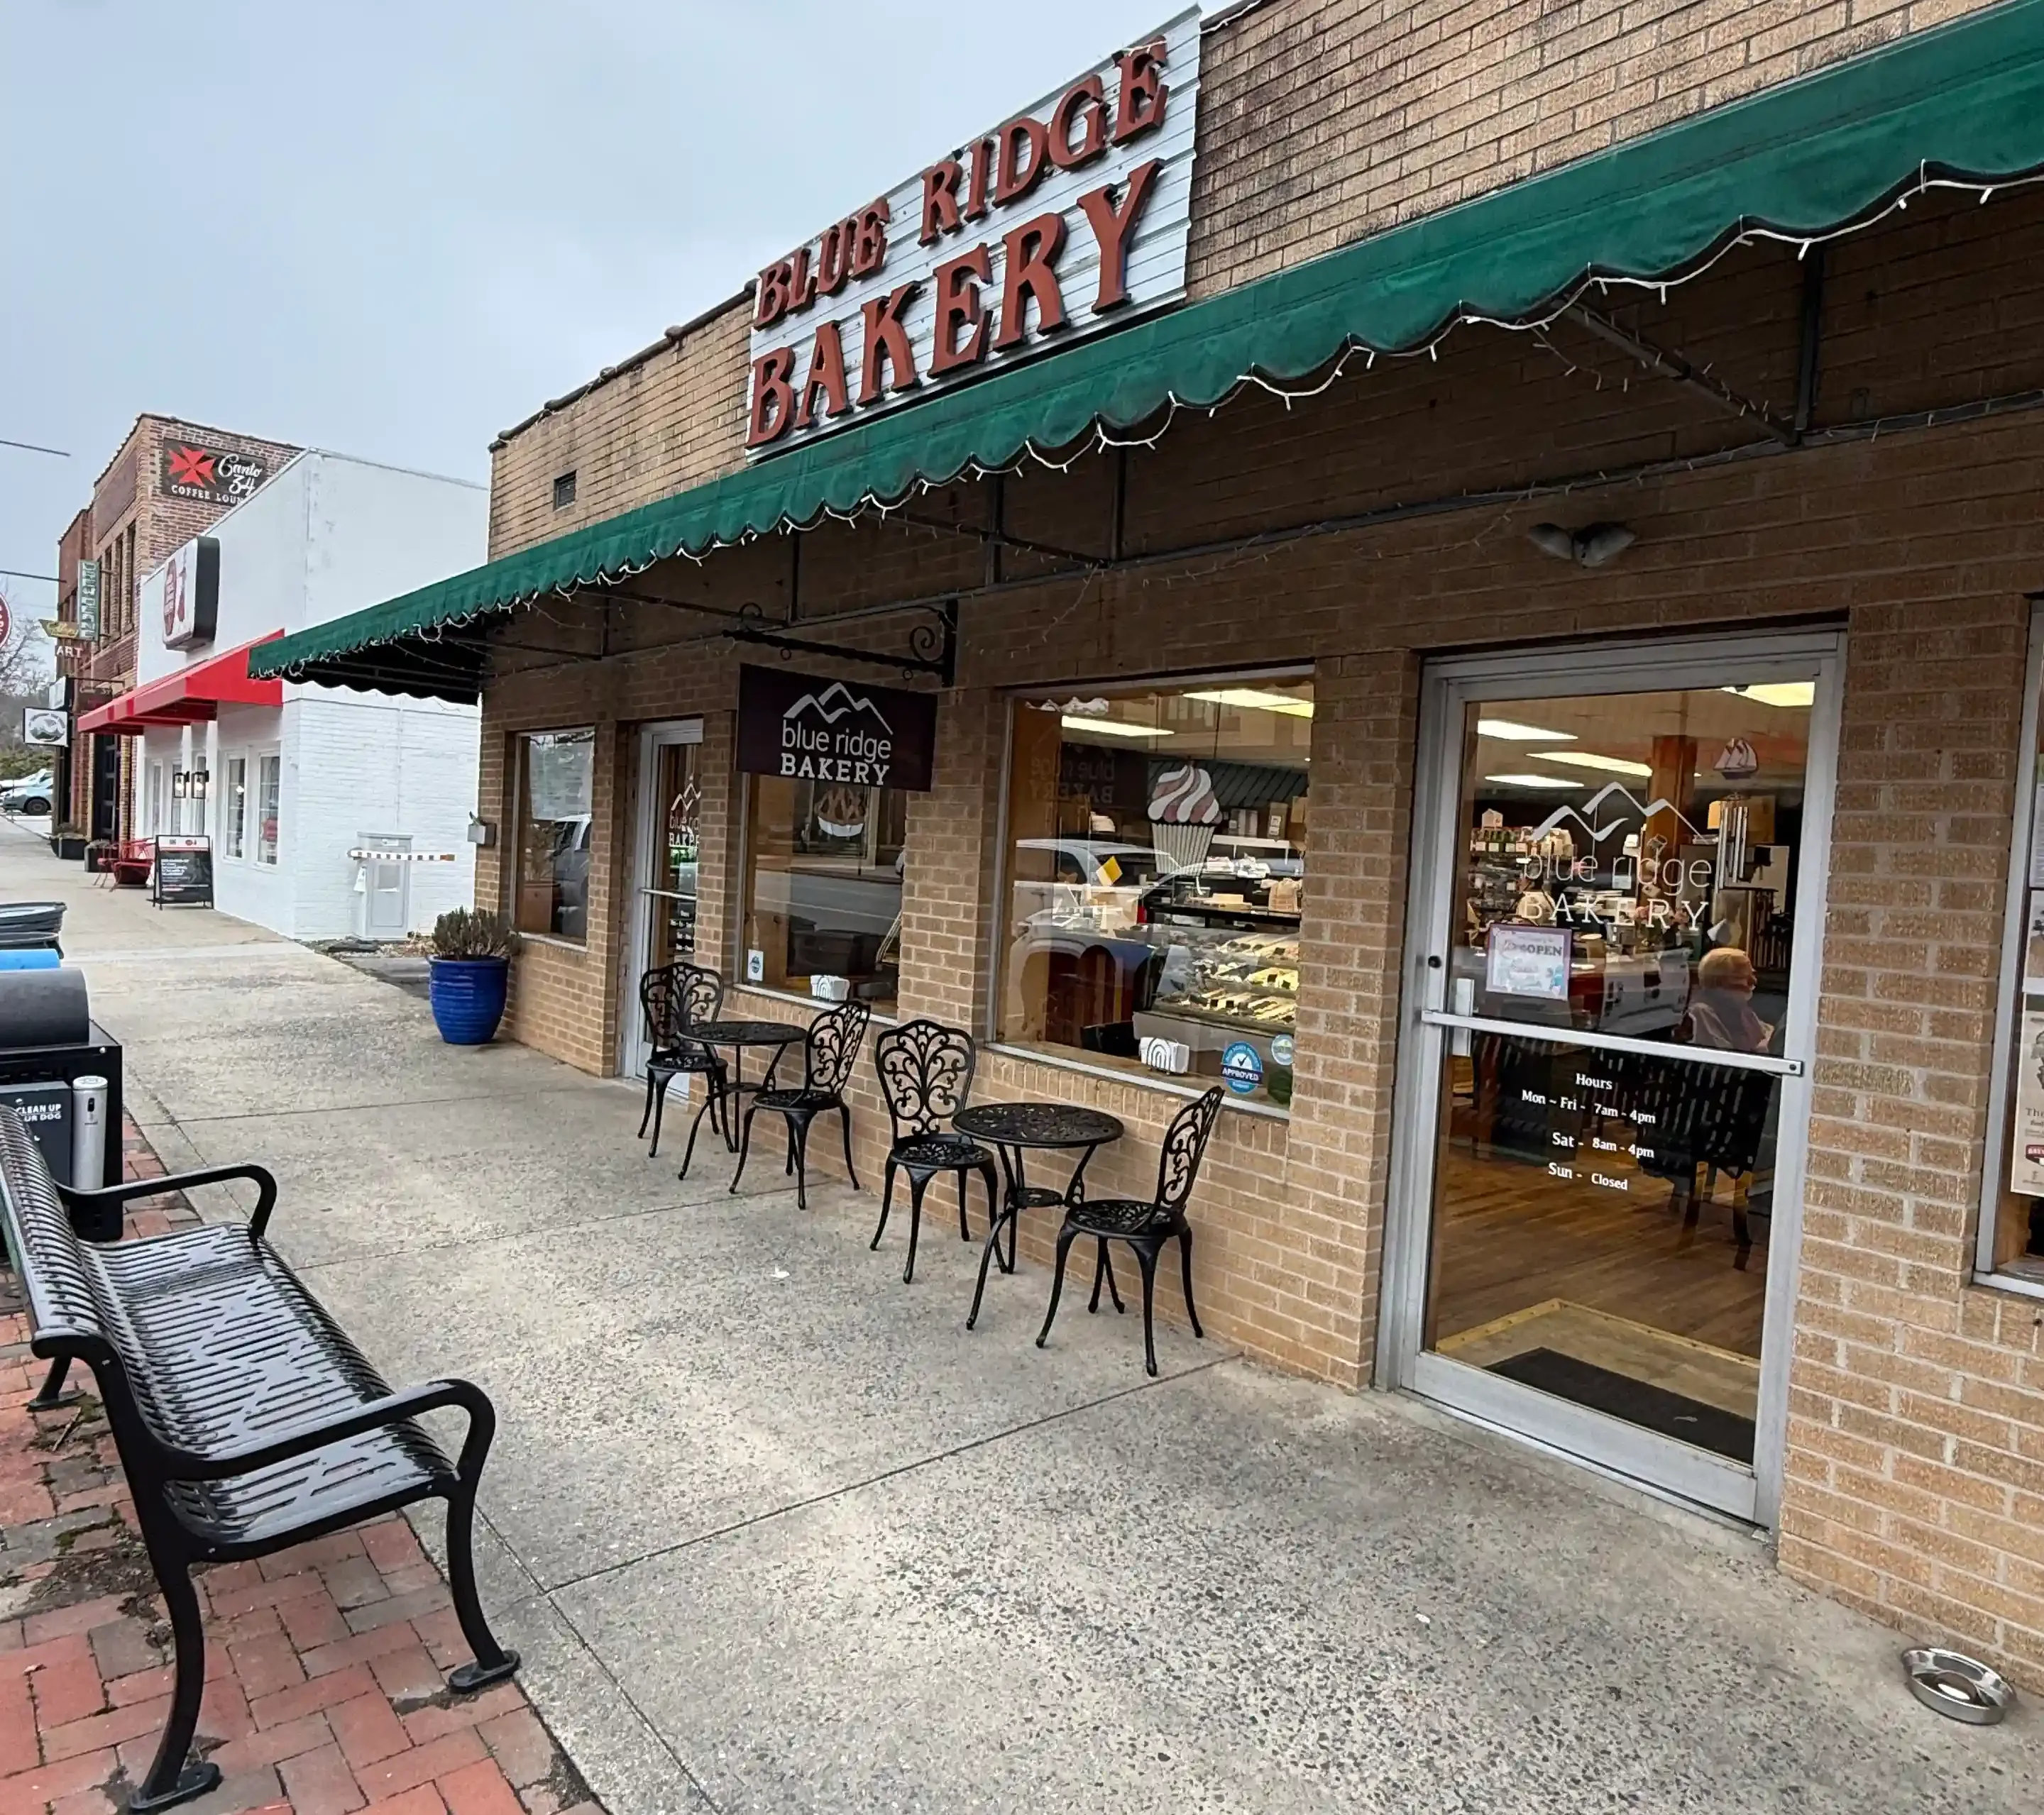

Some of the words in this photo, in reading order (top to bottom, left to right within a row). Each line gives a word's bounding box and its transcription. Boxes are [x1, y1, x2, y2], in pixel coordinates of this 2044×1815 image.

[753, 196, 891, 331] BLUE
[917, 34, 1169, 247] RIDGE
[746, 158, 1165, 449] BAKERY
[218, 453, 263, 478] Canto
[171, 485, 210, 500] COFFEE
[229, 474, 256, 496] 34
[56, 646, 84, 658] ART
[782, 719, 830, 752] blue
[835, 727, 891, 764] ridge
[781, 752, 890, 785] BAKERY
[1523, 847, 1598, 883] blue
[1612, 847, 1713, 896] ridge
[1524, 893, 1709, 931] BAKERY
[1527, 944, 1562, 956] OPEN
[1222, 1067, 1260, 1081] APPROVED
[1576, 1073, 1612, 1090] Hours
[1522, 1089, 1546, 1105] Mon
[1560, 1096, 1577, 1110] Fri
[1594, 1103, 1618, 1118] 7am
[1630, 1110, 1656, 1124] 4pm
[1552, 1132, 1575, 1147] Sat
[1593, 1137, 1617, 1152] 8am
[1628, 1144, 1654, 1159] 4pm
[1548, 1162, 1573, 1179] Sun
[1591, 1173, 1627, 1190] Closed
